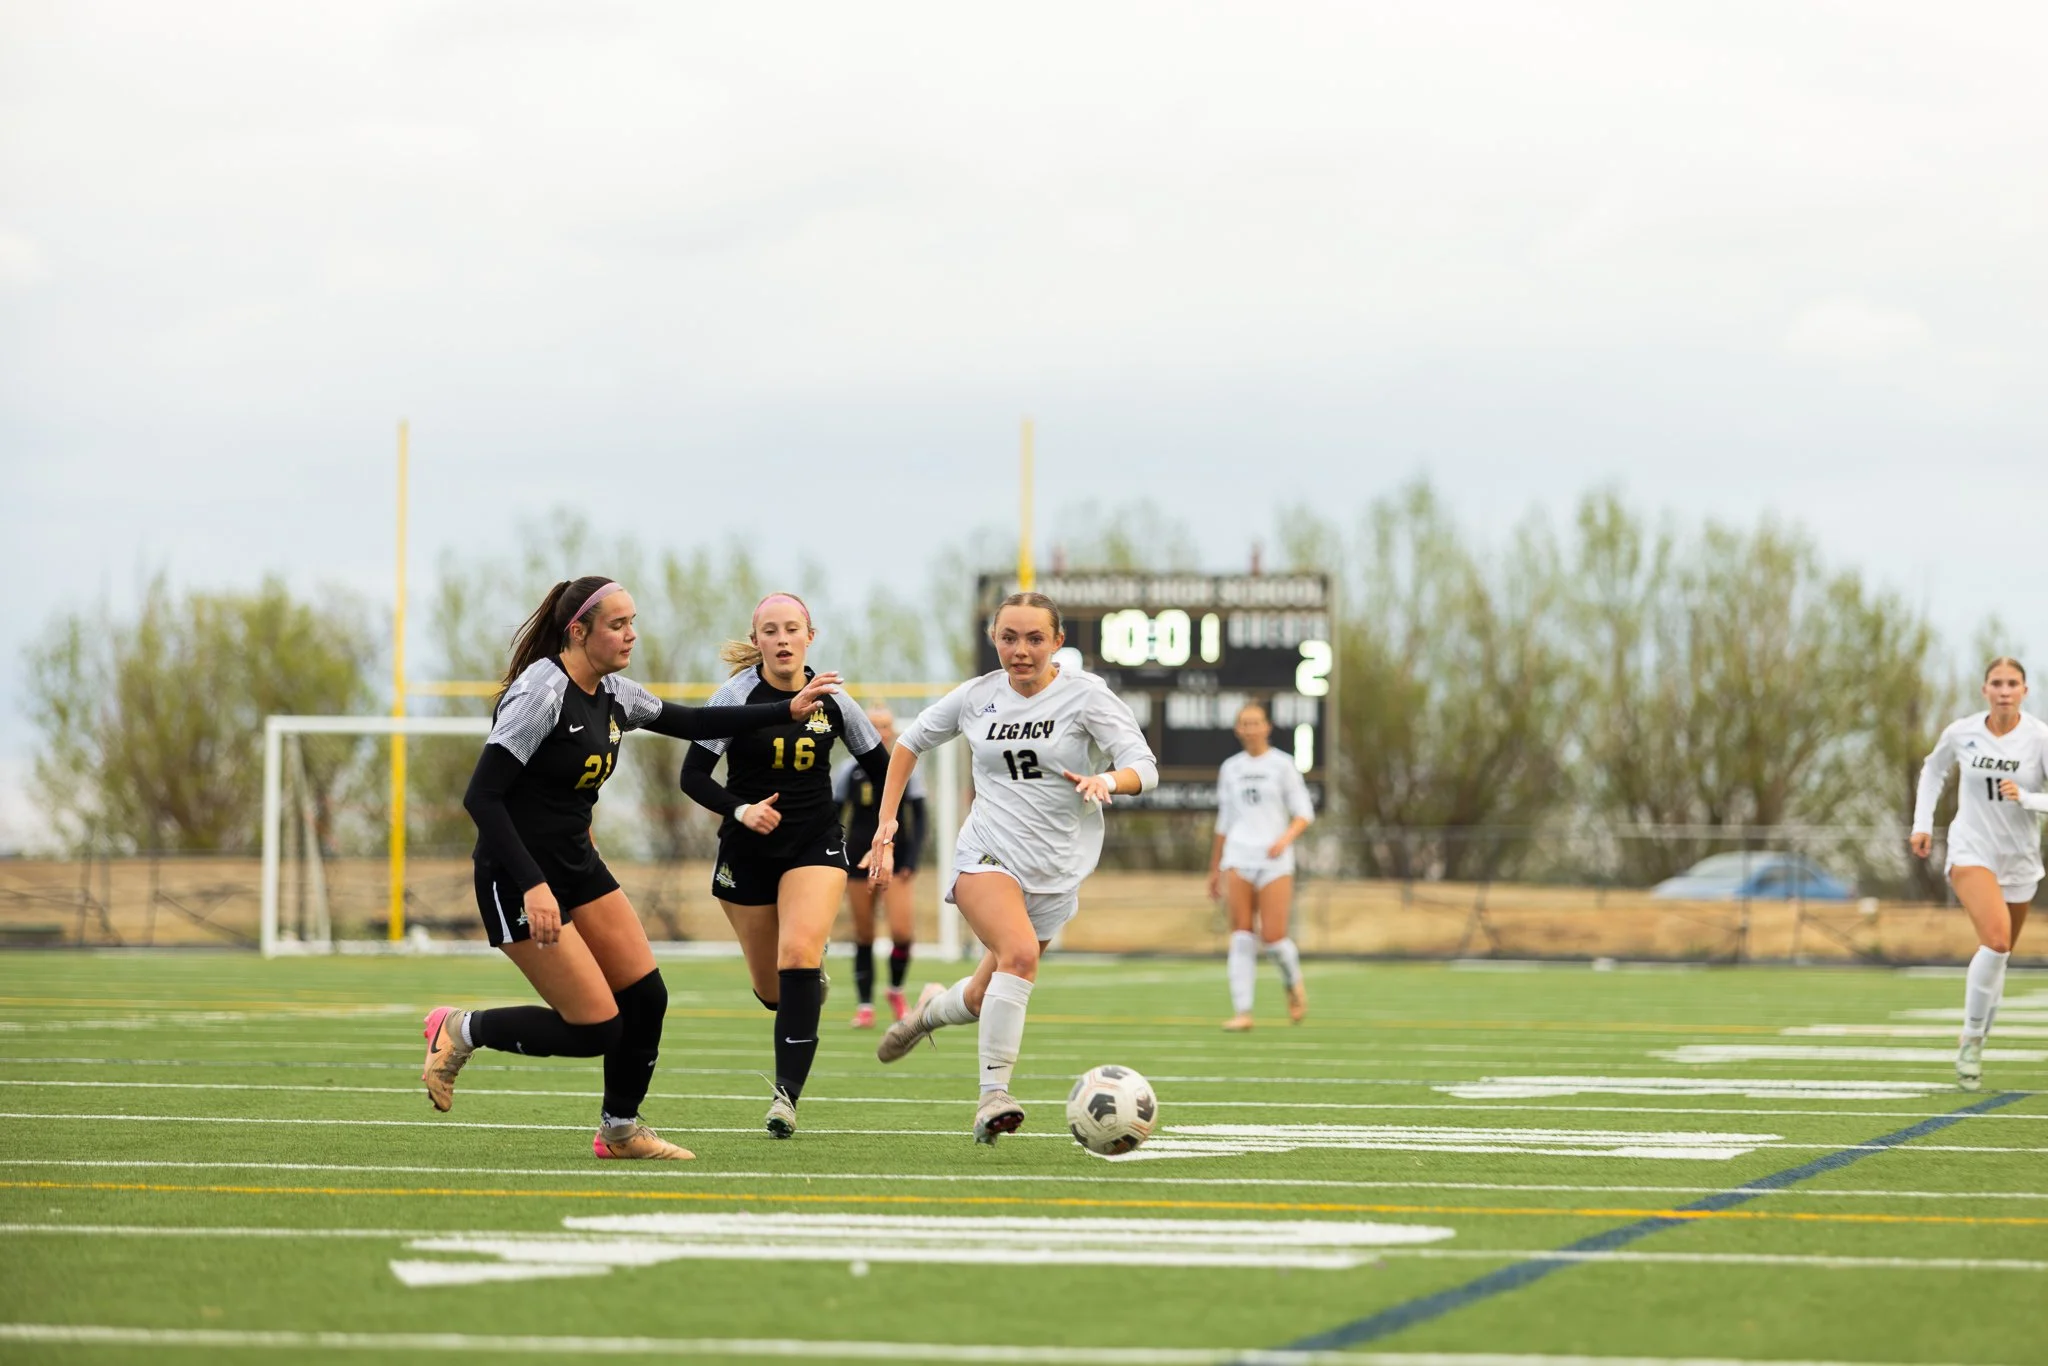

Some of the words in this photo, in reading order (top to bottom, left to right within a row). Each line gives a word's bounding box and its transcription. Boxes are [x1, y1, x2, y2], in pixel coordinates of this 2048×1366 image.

[1296, 640, 1332, 696] 2
[985, 720, 1055, 741] LEGACY
[772, 737, 816, 771] 16
[1003, 749, 1043, 781] 12
[1294, 723, 1313, 773] 1
[1971, 755, 2020, 773] LEGACY
[574, 752, 612, 790] 21
